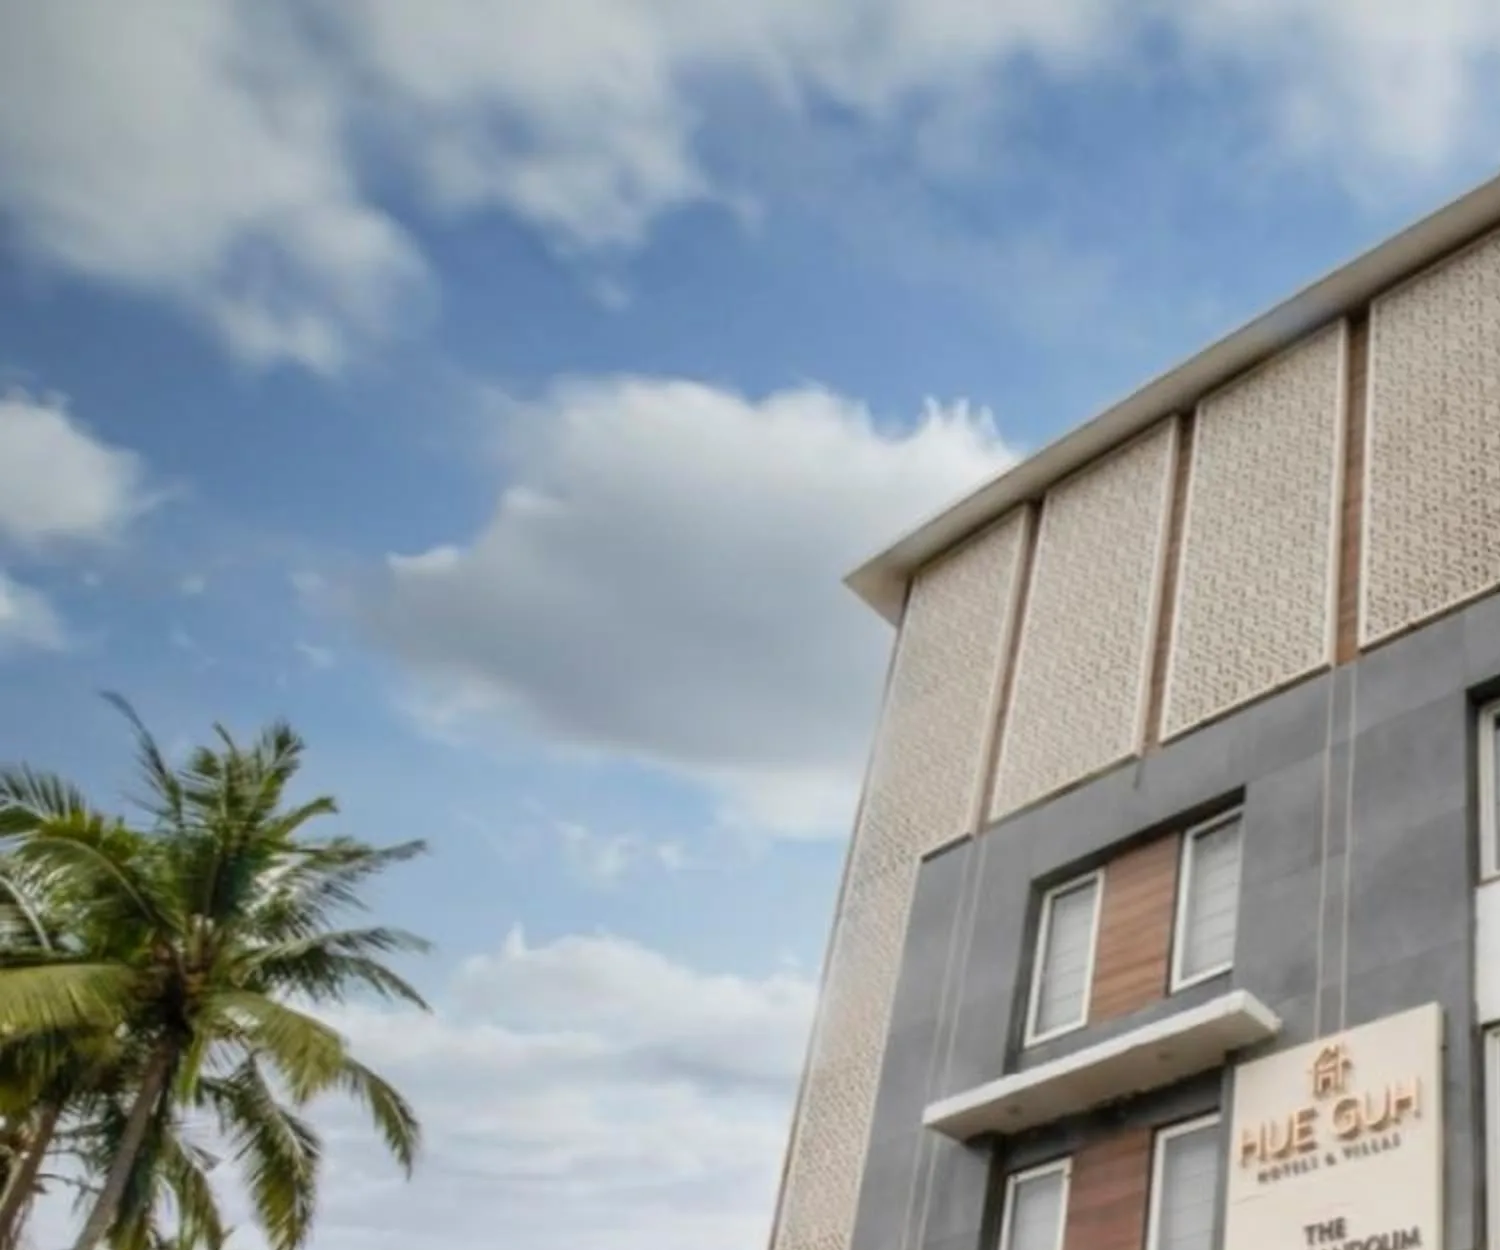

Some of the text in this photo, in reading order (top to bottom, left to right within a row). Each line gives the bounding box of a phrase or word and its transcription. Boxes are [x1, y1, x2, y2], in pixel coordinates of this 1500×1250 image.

[1240, 1076, 1422, 1169] HUE GUH
[1303, 1217, 1346, 1245] THE
